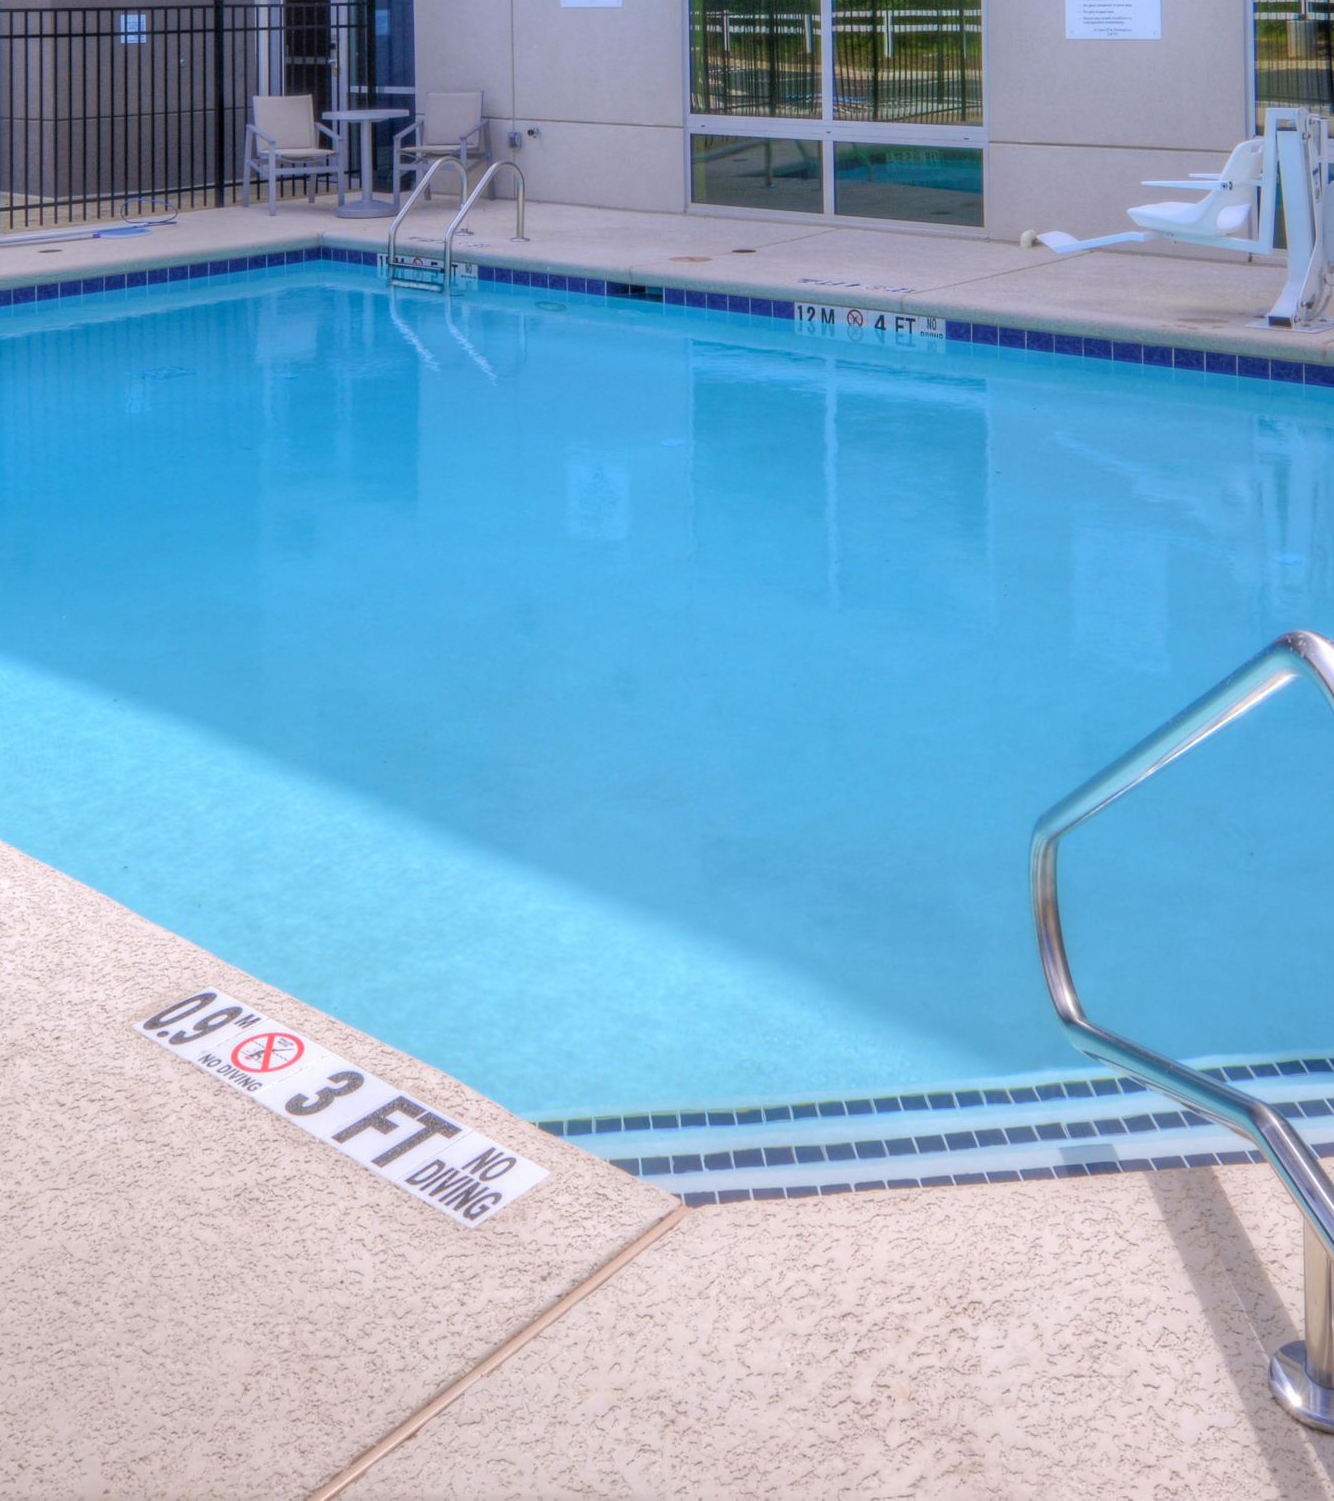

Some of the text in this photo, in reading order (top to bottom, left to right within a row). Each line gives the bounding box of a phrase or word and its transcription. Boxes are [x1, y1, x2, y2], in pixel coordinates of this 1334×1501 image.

[821, 307, 835, 325] M
[874, 314, 887, 331] 4
[895, 316, 916, 334] FT
[926, 317, 937, 330] NO
[198, 1052, 263, 1093] NO DIVING
[284, 1070, 464, 1169] 3 FT
[460, 1146, 518, 1182] NO
[405, 1159, 504, 1221] DIVING
